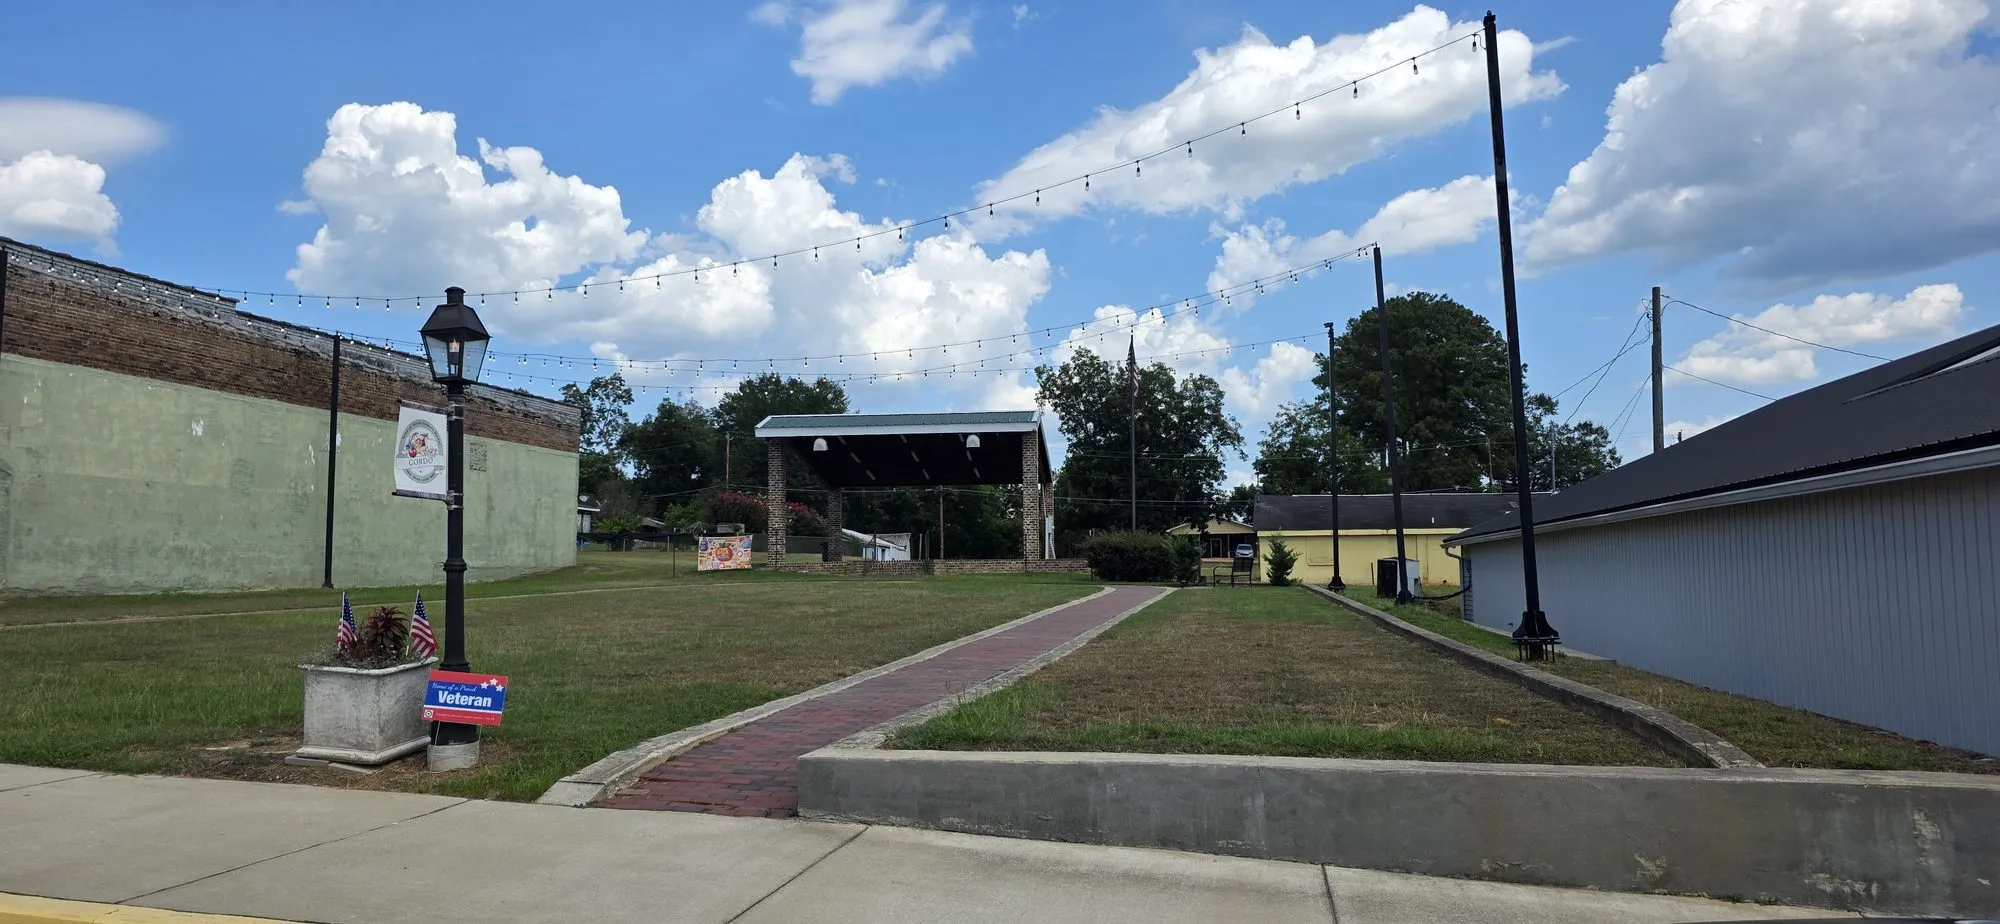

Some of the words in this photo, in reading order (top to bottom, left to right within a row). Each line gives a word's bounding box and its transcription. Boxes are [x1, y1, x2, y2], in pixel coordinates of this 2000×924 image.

[409, 457, 433, 466] GORDO
[460, 684, 477, 692] Proud
[438, 690, 492, 707] Veteran
